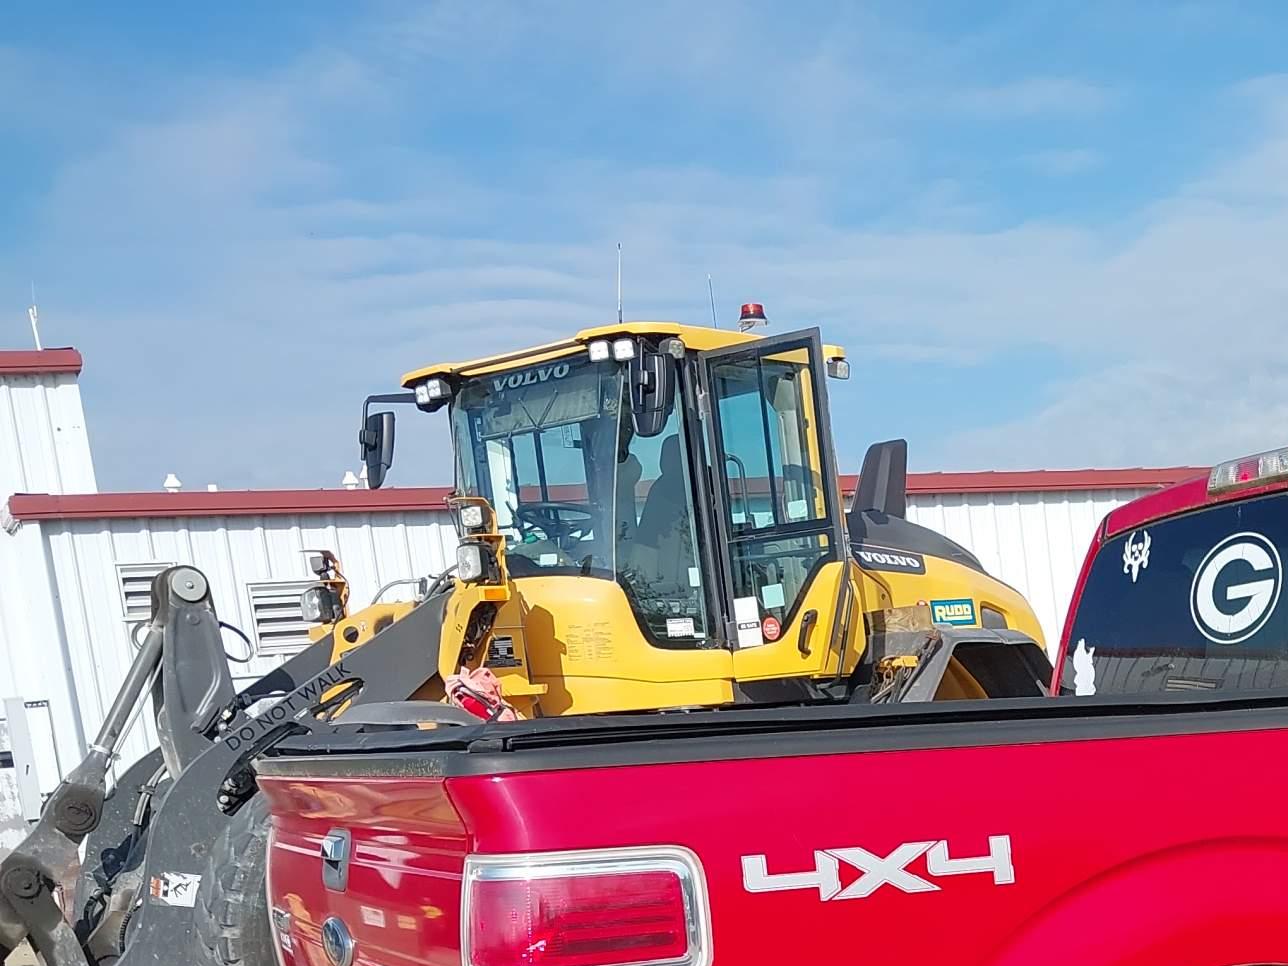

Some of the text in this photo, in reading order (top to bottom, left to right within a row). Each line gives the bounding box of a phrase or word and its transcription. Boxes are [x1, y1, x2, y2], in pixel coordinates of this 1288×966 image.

[493, 364, 570, 392] VOLVO
[855, 551, 921, 568] VOLVO
[1196, 542, 1275, 634] G
[935, 603, 973, 622] RUDD
[224, 662, 352, 752] DO NOT WALK
[740, 834, 1016, 902] 4X4
